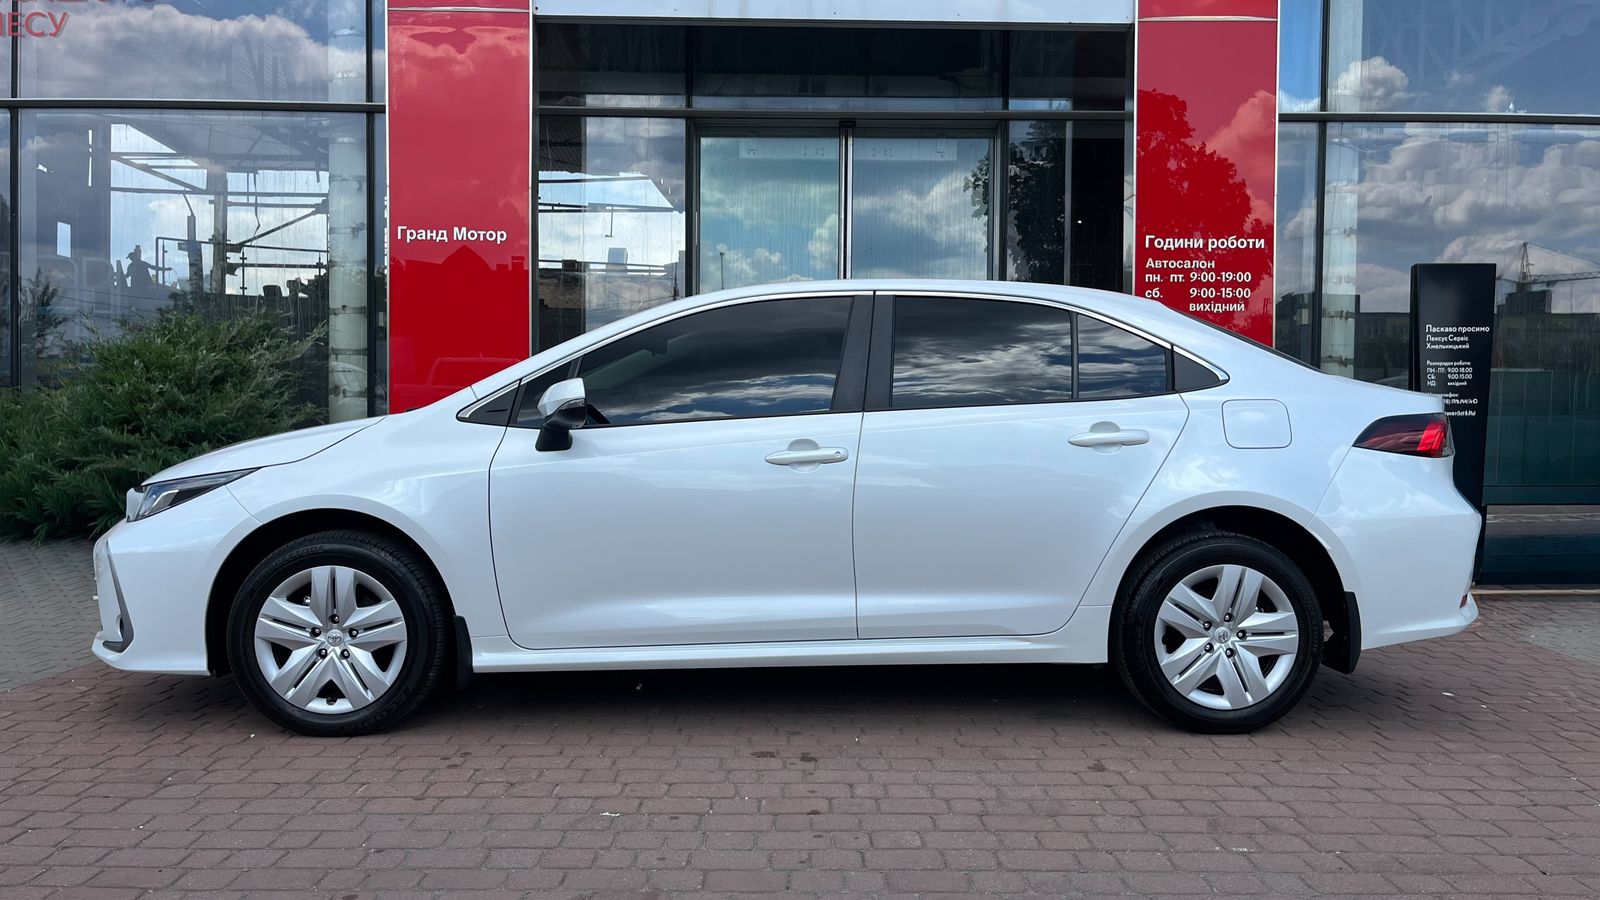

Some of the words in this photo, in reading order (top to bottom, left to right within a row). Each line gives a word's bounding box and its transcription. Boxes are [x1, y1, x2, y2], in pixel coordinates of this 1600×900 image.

[397, 225, 448, 243] Гранд
[453, 226, 507, 244] Мотор
[1145, 235, 1204, 251] Години
[1208, 235, 1265, 252] роботи
[1145, 258, 1215, 269] Автосалон
[1145, 273, 1163, 283] пн.
[1170, 273, 1185, 283] пт.
[1189, 271, 1252, 283] 9:00-19:00
[1145, 287, 1163, 298] сб.
[1189, 287, 1251, 298] 9:00-15:00
[1189, 301, 1245, 313] вихідний
[1425, 324, 1457, 333] Ласкаво
[1458, 326, 1490, 334] просимо
